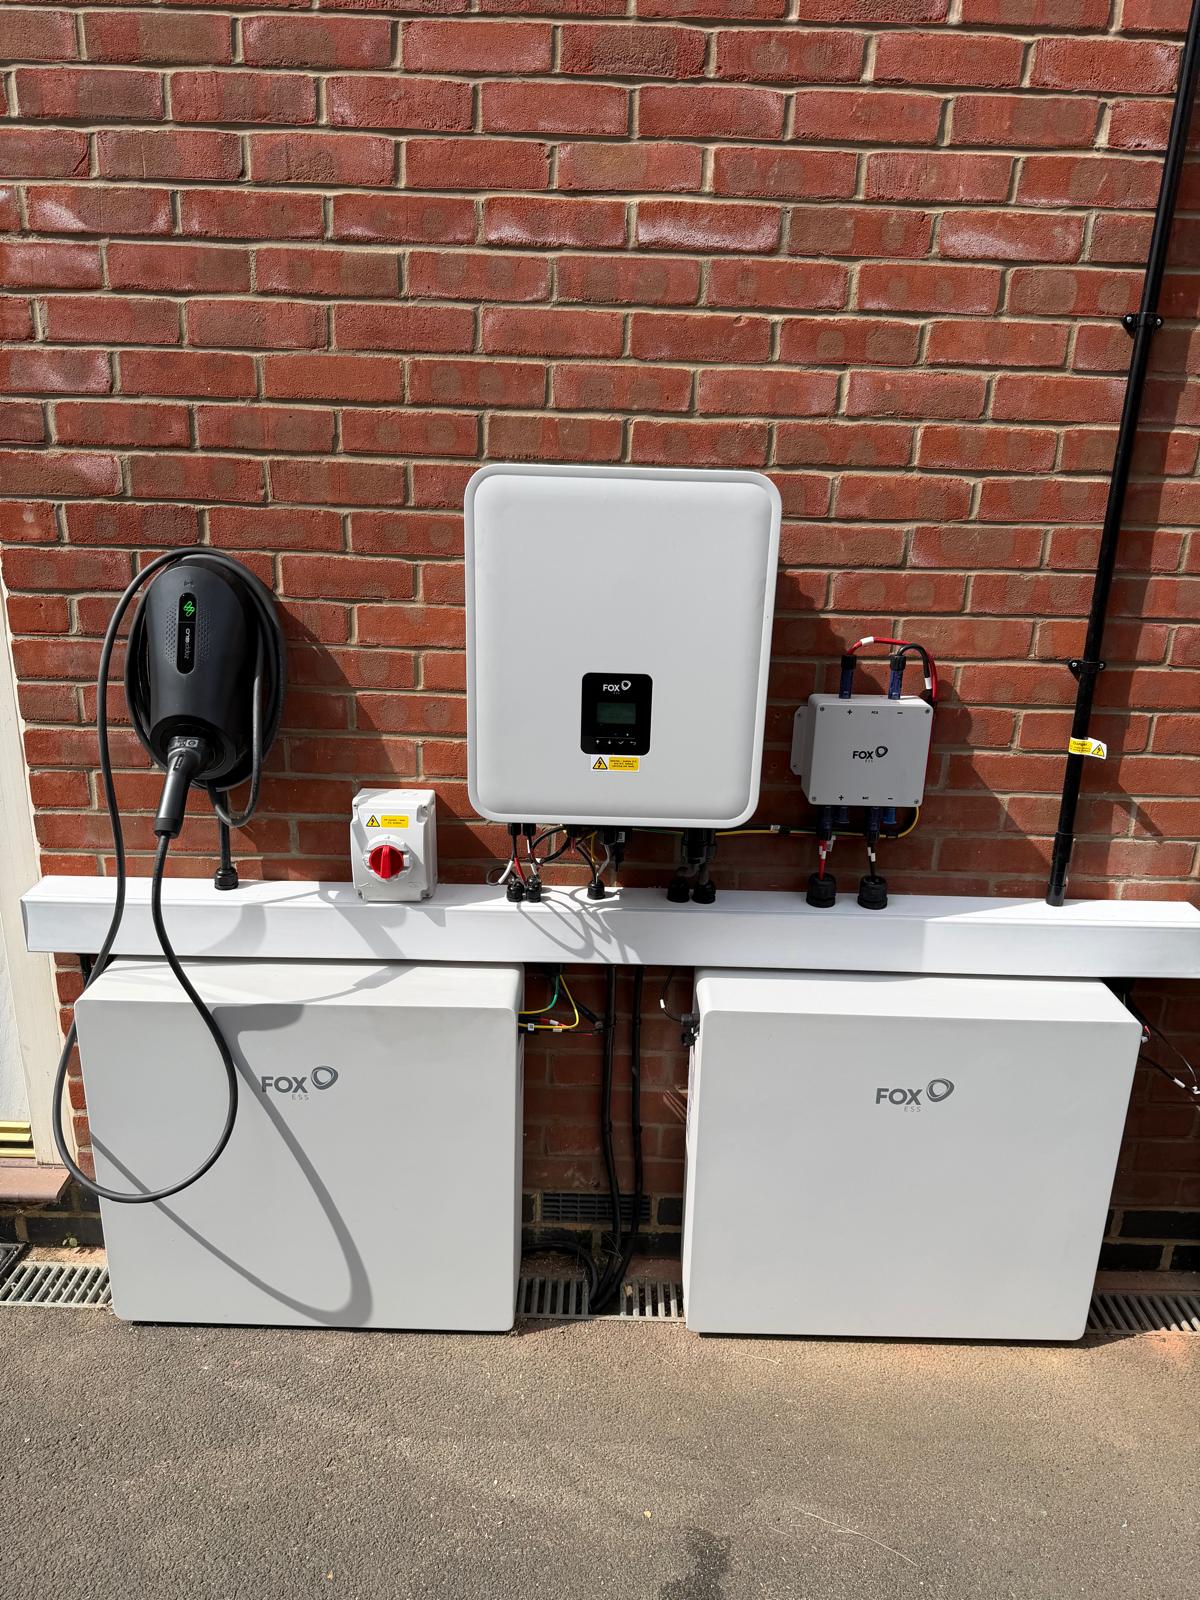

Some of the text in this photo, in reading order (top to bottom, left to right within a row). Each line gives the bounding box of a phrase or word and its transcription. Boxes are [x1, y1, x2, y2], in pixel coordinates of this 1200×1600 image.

[602, 684, 620, 692] FOX
[852, 750, 874, 760] FOX
[261, 1076, 308, 1093] FOX
[875, 1087, 923, 1105] FOX
